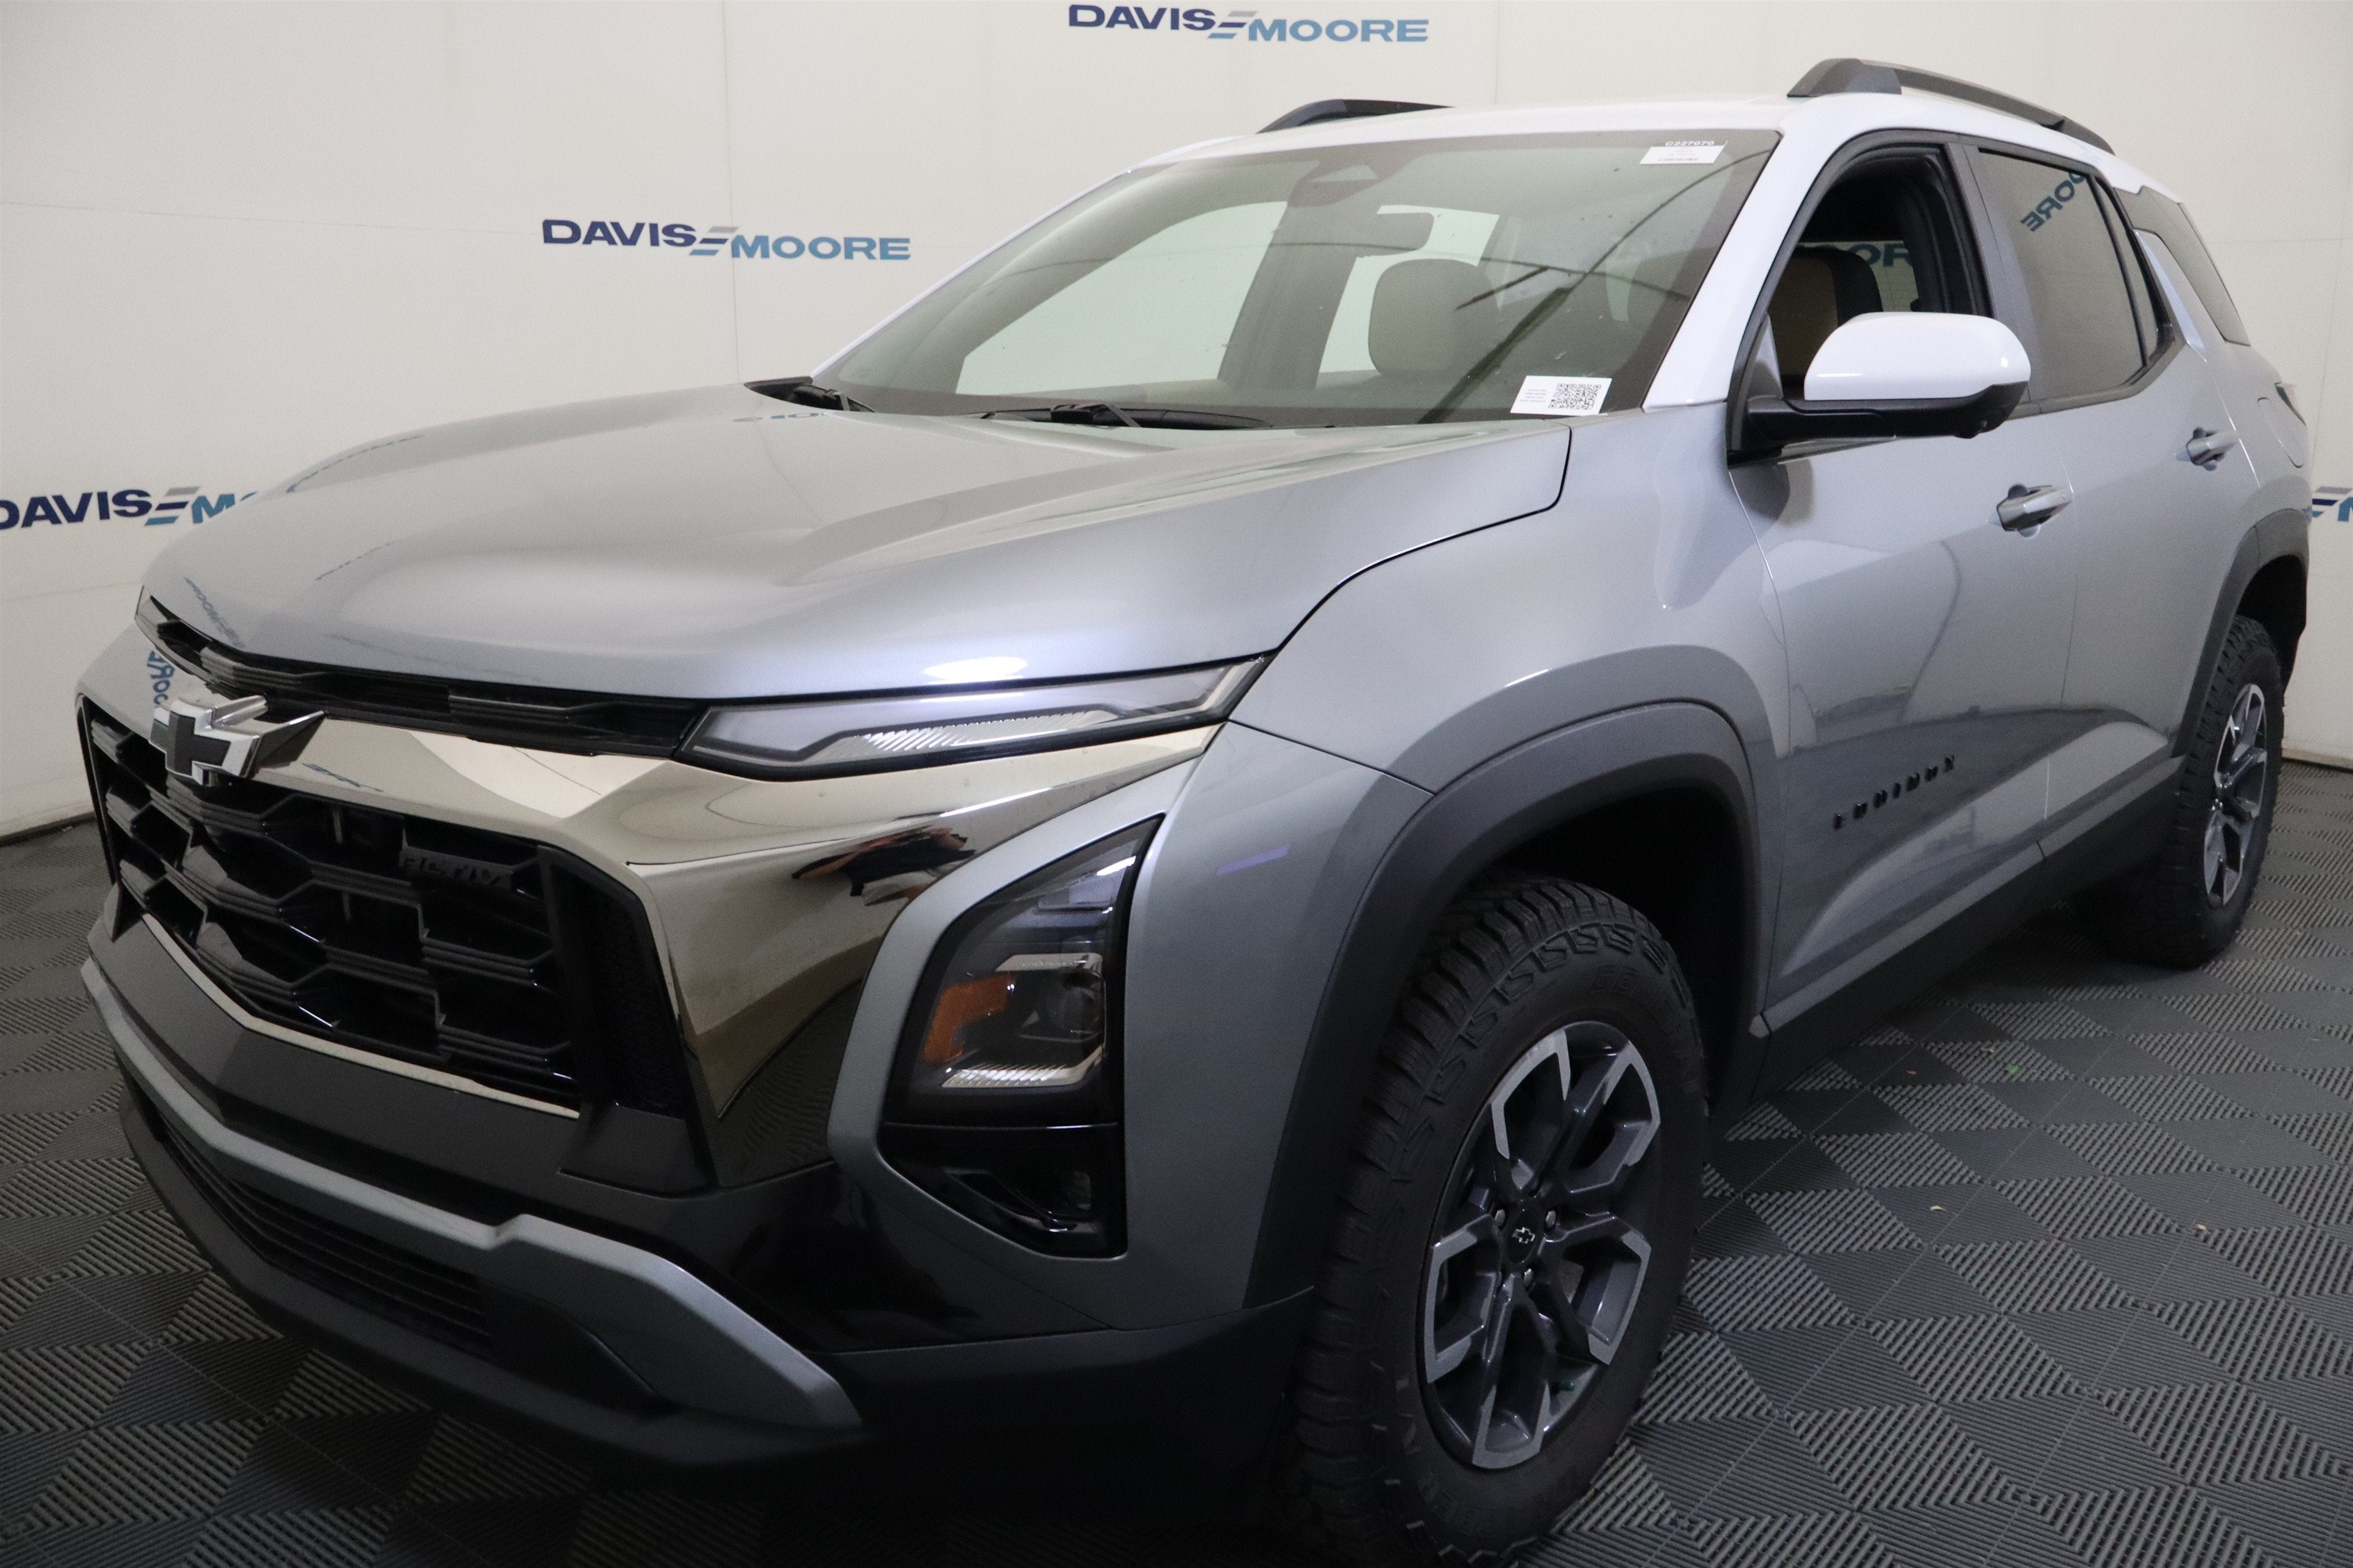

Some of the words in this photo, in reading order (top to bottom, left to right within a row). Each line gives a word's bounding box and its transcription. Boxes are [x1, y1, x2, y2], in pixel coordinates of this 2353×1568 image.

[1068, 3, 1216, 32] DAVIS
[1248, 18, 1429, 42] MOORE
[541, 218, 697, 248] DAVIS
[730, 234, 912, 261] MOORE
[0, 488, 153, 532] DAVIS
[190, 491, 257, 525] M
